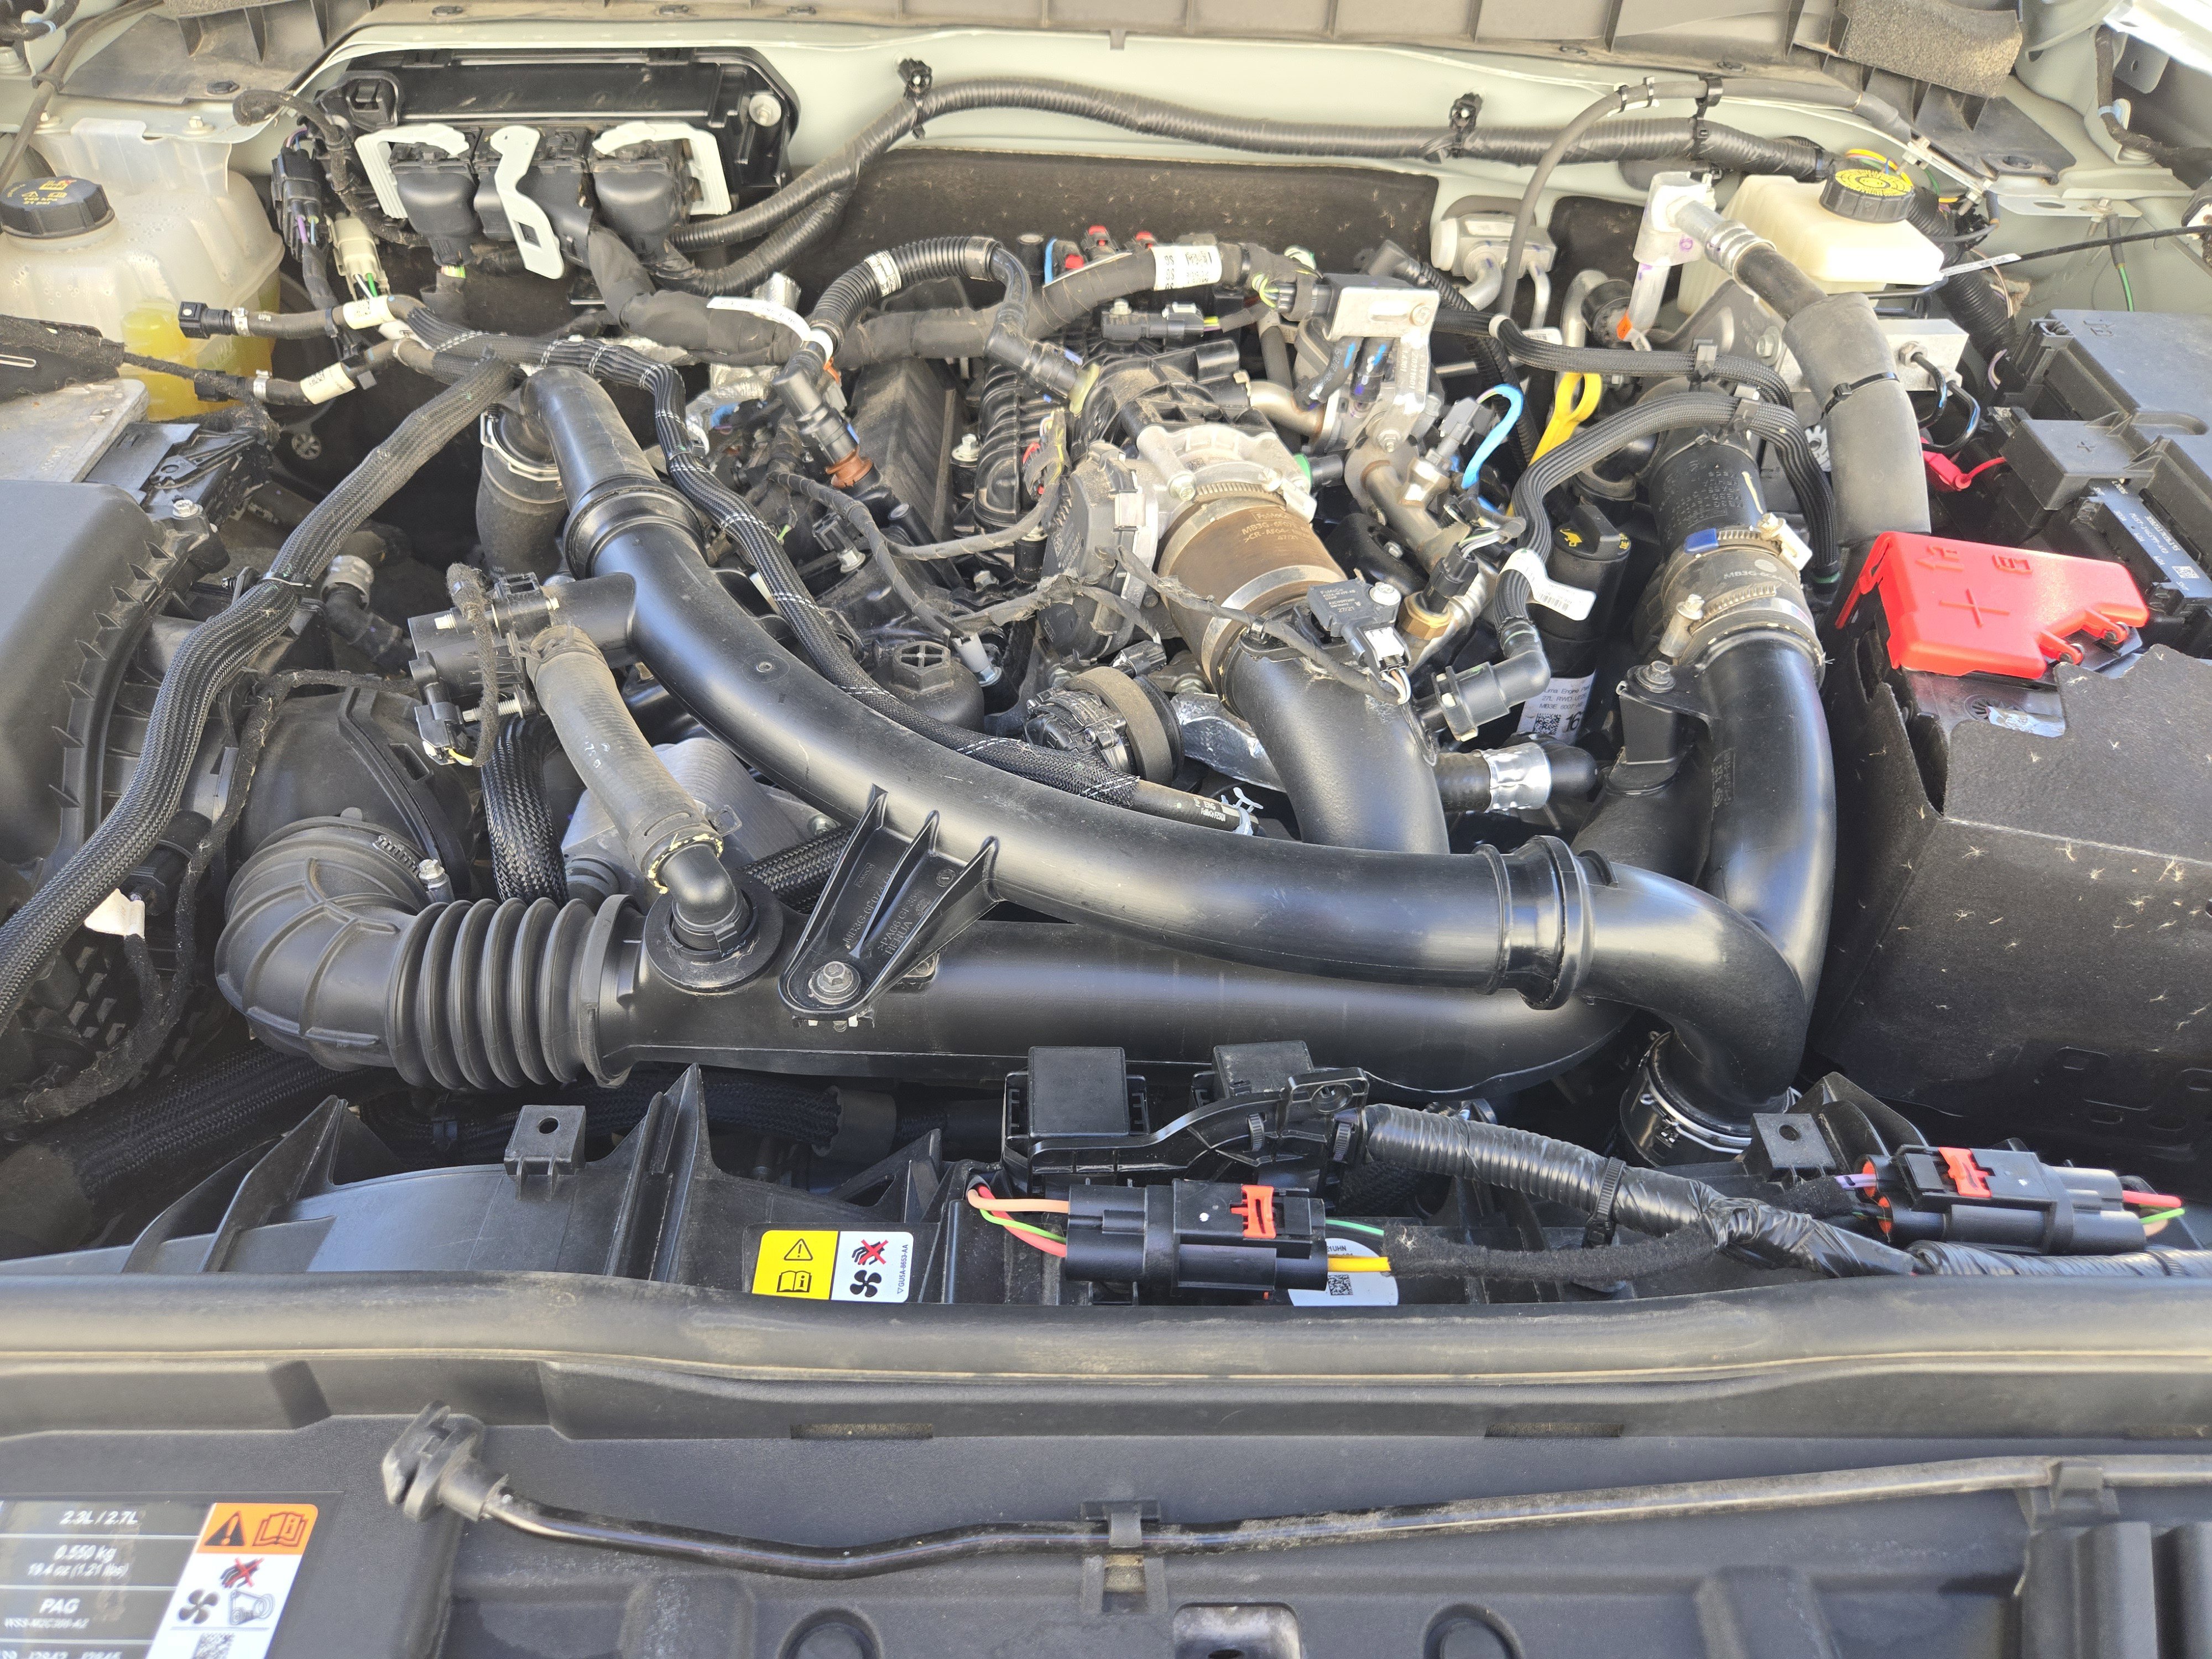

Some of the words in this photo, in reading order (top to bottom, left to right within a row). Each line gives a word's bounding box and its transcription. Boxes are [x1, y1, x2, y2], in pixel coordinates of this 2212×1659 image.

[258, 314, 272, 322] UPR
[59, 1510, 94, 1525] 2.3L
[103, 1510, 138, 1525] 2.7L
[95, 1545, 118, 1564] kg
[39, 1598, 81, 1614] PAG
